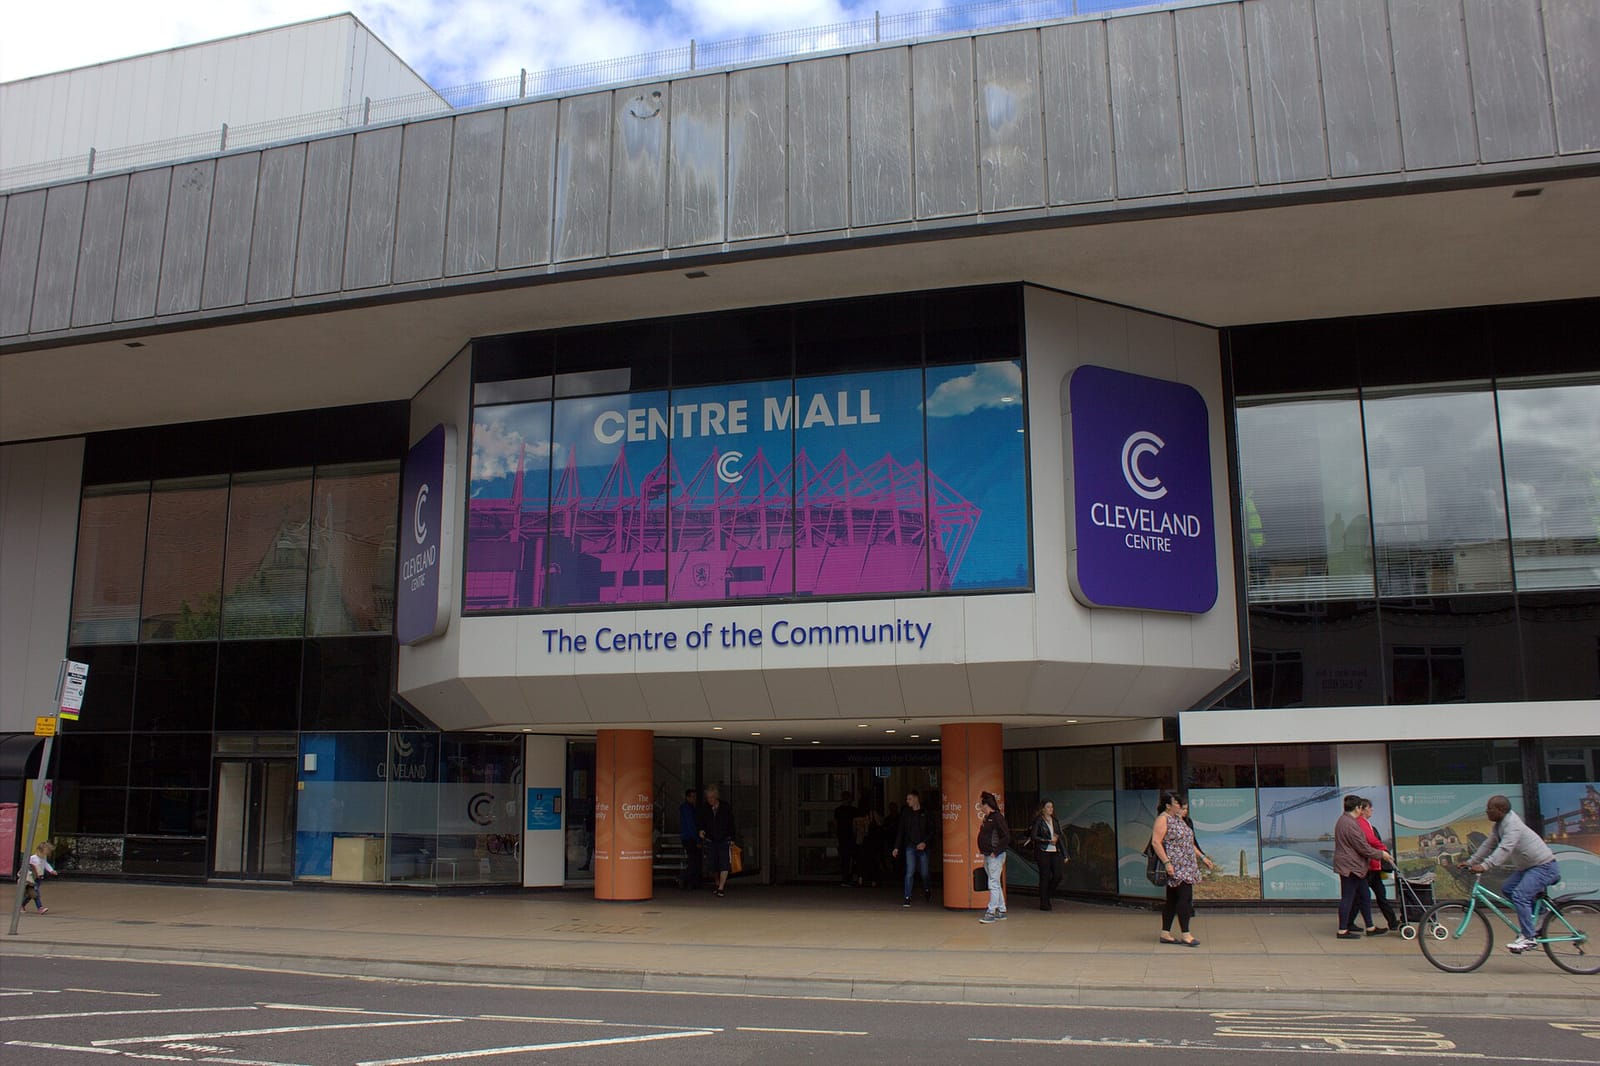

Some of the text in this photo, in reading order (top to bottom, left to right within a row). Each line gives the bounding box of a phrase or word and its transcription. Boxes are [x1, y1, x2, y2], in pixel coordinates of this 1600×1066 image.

[593, 389, 880, 444] CENTRE MALL
[1090, 502, 1201, 538] CLEVELAND
[1125, 533, 1172, 553] CENTRE
[402, 544, 436, 580] CLEVELAND
[542, 618, 932, 653] The Centre of the Community
[622, 803, 645, 811] Centre
